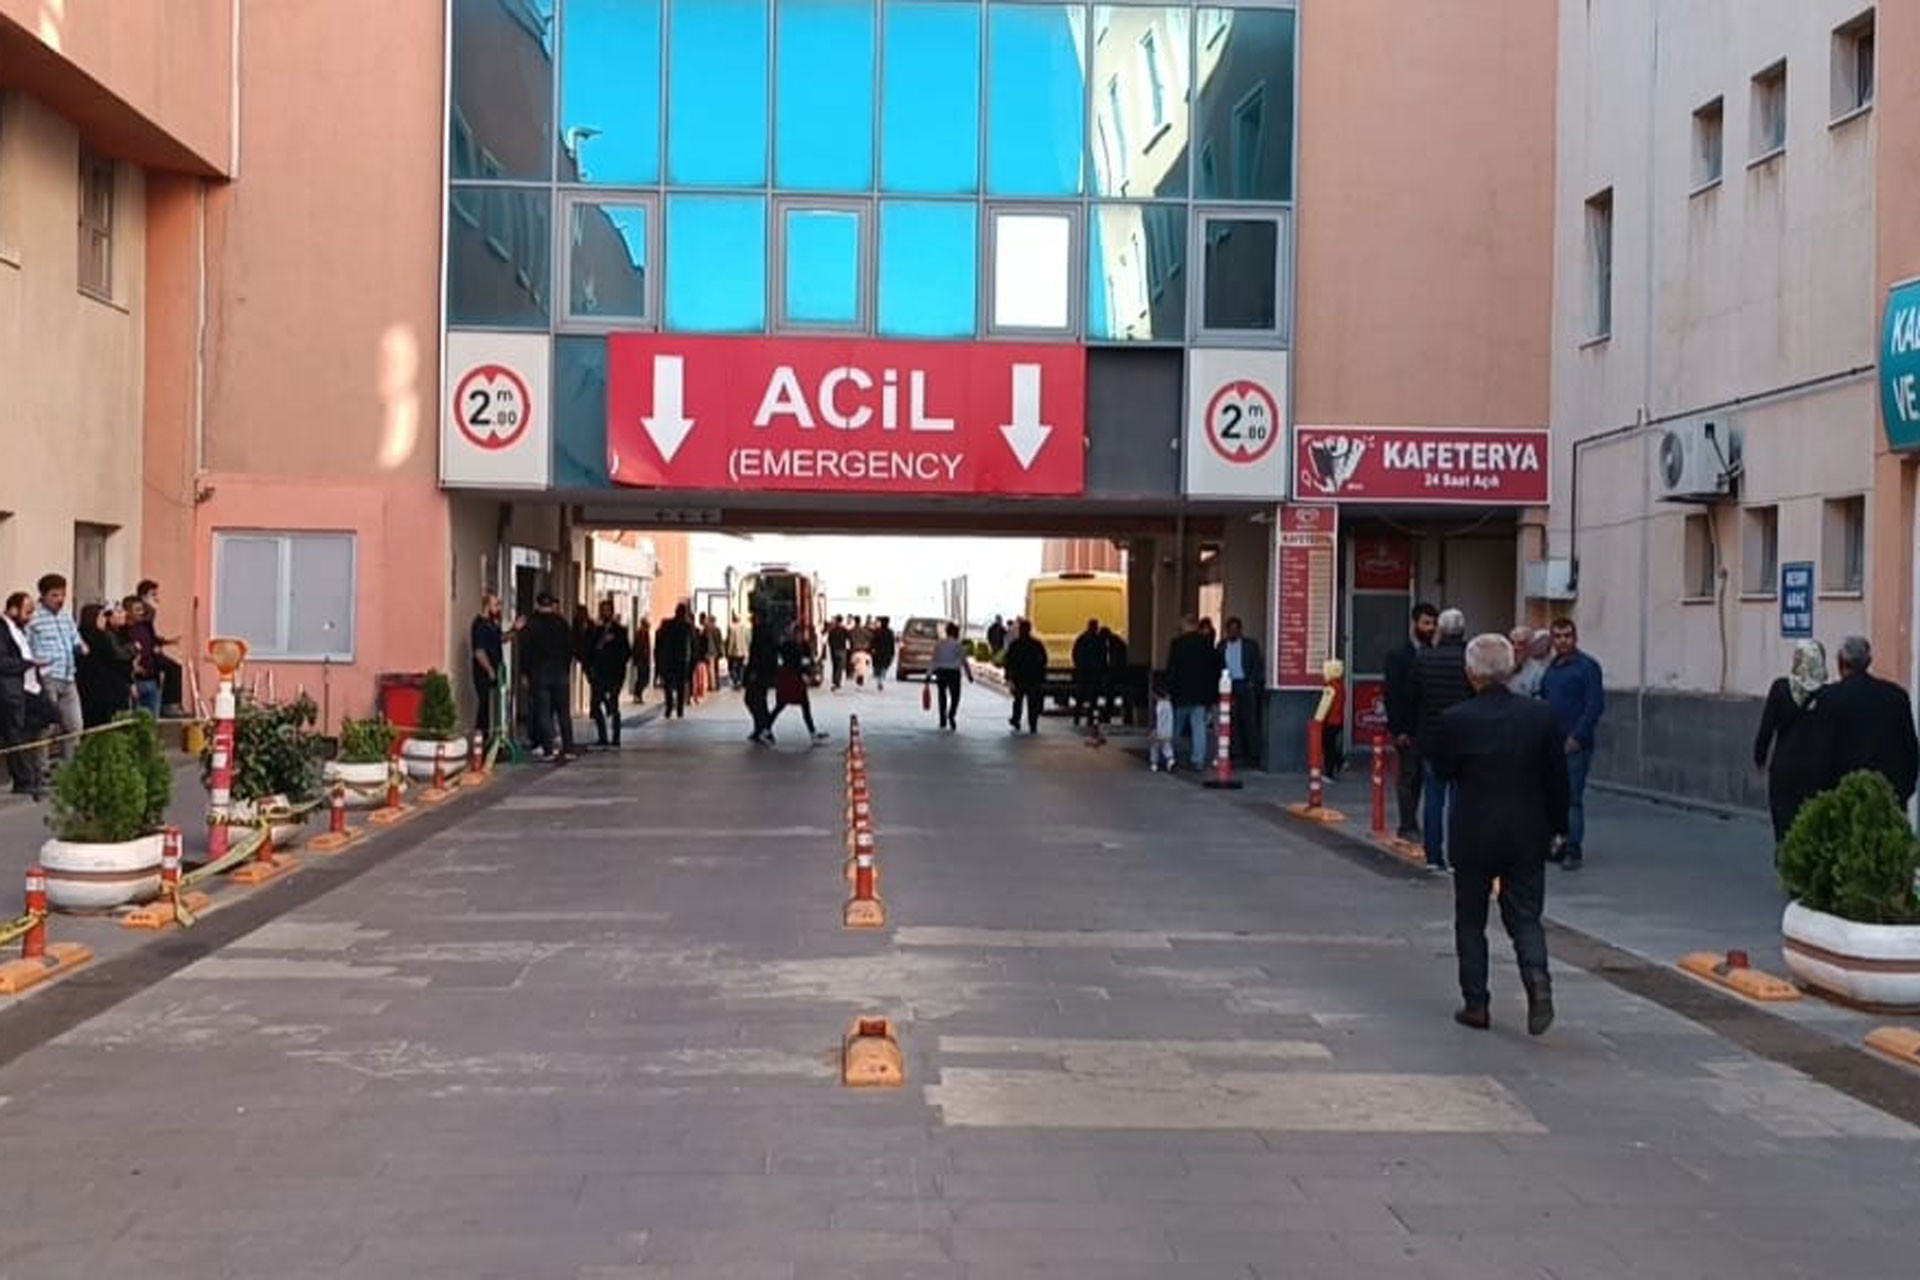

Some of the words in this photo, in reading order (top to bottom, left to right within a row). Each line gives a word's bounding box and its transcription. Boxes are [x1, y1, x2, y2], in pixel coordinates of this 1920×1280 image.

[469, 390, 491, 425] 2
[1893, 373, 1920, 421] VE
[1221, 403, 1242, 439] 2
[729, 448, 963, 482] (EMERGENCY
[1383, 441, 1538, 470] KAFETERYA
[1442, 473, 1469, 489] Saat
